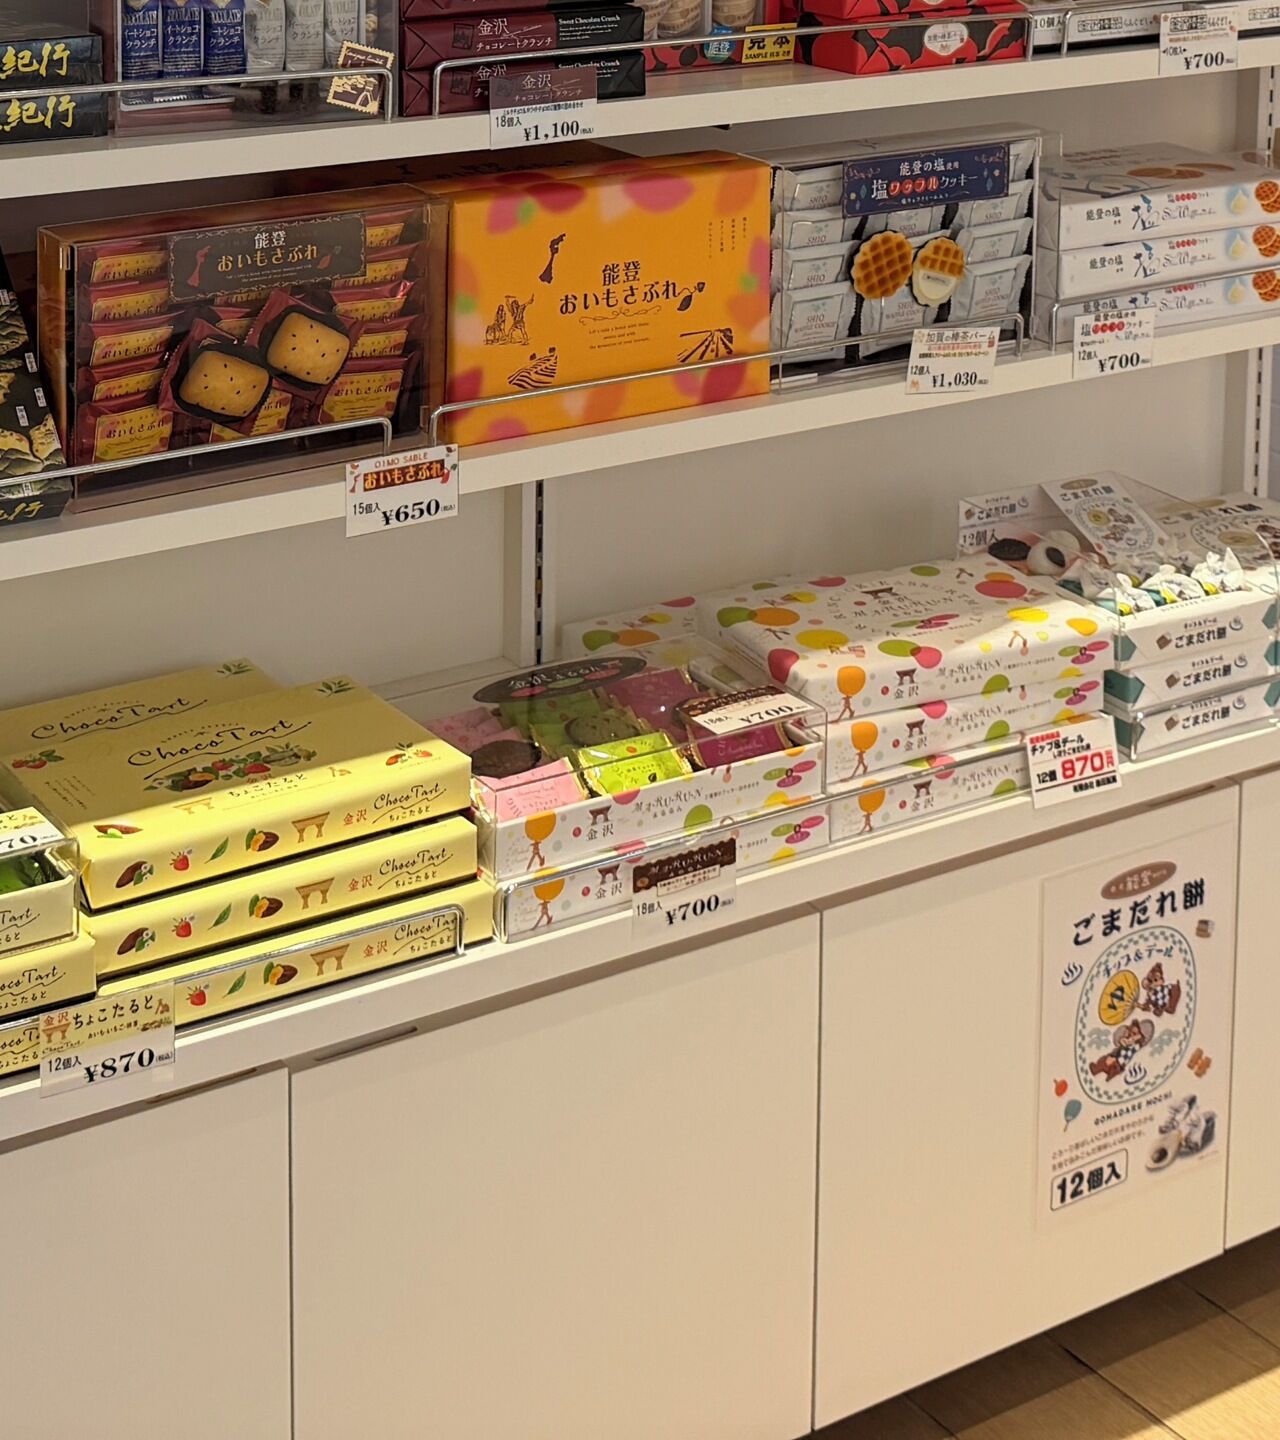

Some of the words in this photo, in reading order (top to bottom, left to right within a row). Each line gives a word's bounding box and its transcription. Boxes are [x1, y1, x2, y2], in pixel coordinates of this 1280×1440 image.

[1183, 51, 1225, 70] ¥700
[523, 121, 580, 142] ¥1,100
[871, 173, 978, 200] 塩ワッフルクッキー
[254, 230, 288, 249] 能登
[218, 243, 318, 273] おいもさぶれ
[601, 261, 642, 287] 能登
[559, 280, 680, 316] おいもさぶれ
[1098, 352, 1140, 372] ¥700
[932, 371, 977, 388] ¥1,030
[363, 460, 445, 491] おいもさぶれ
[352, 502, 382, 517] 15個入
[381, 498, 441, 526] ¥650
[666, 895, 719, 925] ¥700
[1072, 878, 1205, 947] ごまだれ餅
[73, 996, 153, 1029] ちょこたると
[47, 1055, 82, 1072] 12個入
[84, 1048, 154, 1083] ¥870
[1056, 1161, 1122, 1204] 12個入
